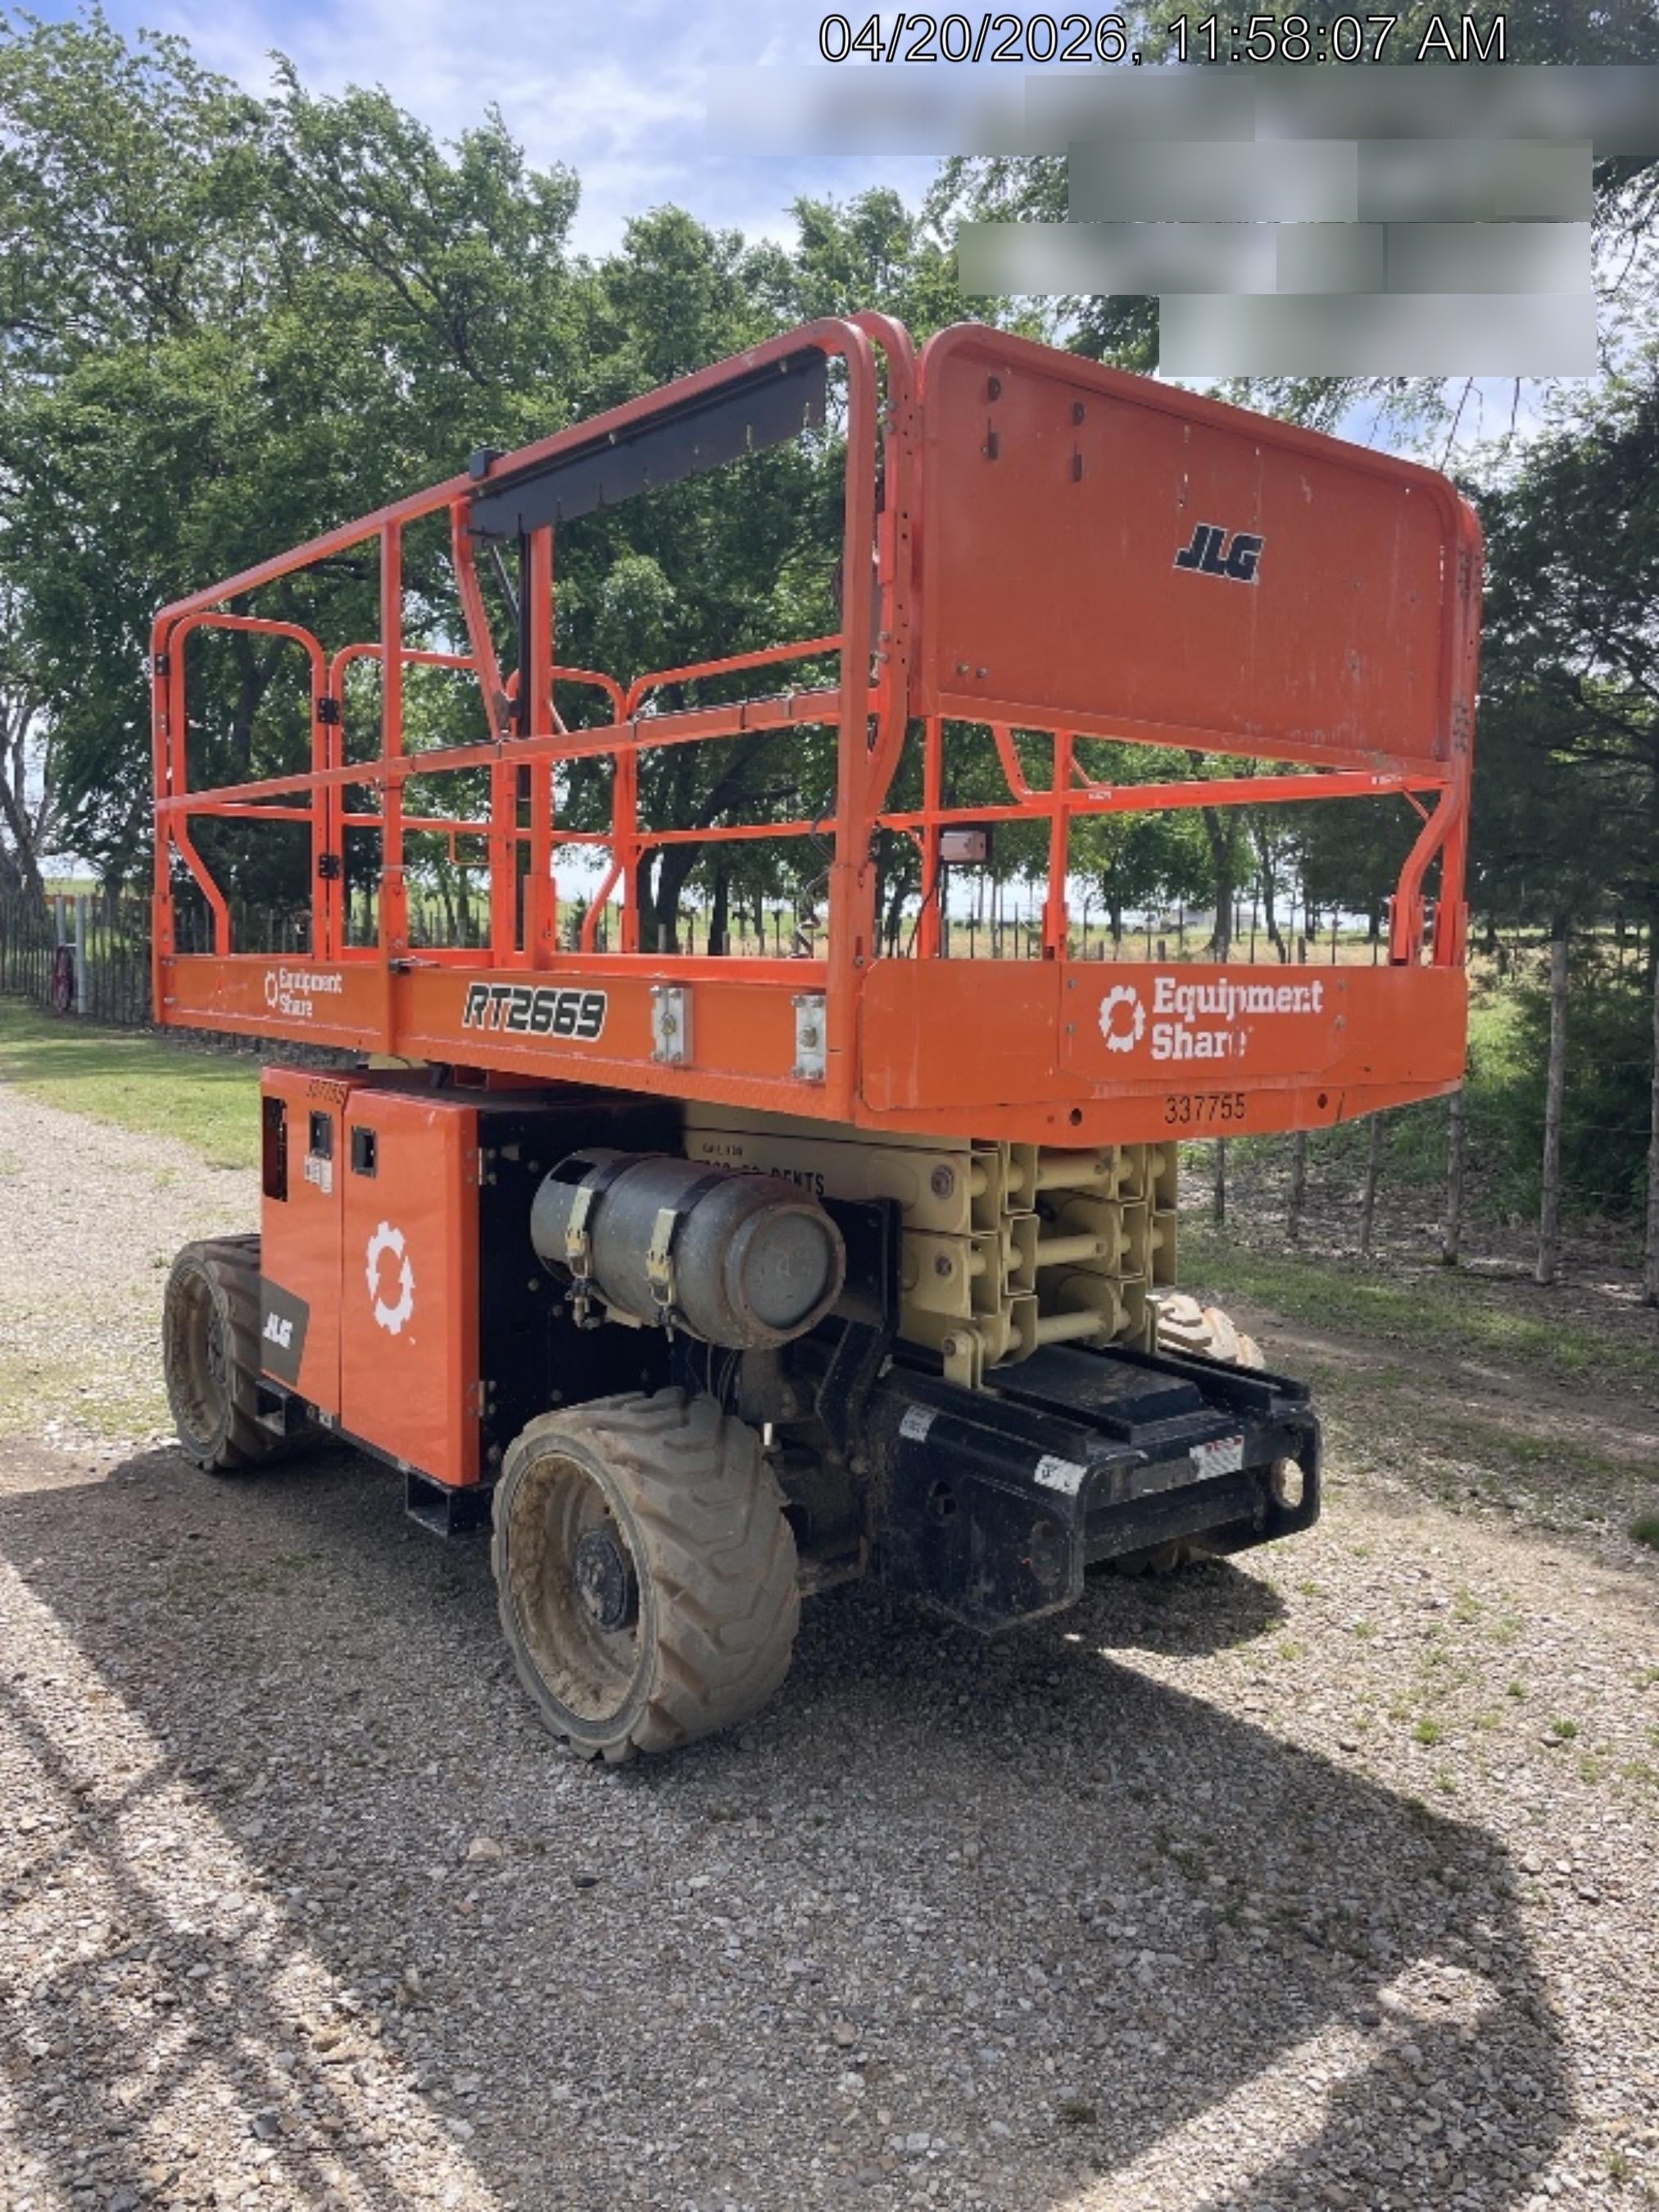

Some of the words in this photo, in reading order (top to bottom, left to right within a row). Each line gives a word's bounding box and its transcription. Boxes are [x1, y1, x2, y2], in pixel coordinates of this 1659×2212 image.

[1173, 522, 1266, 585] JLG
[279, 968, 342, 995] Equipment
[1153, 977, 1323, 1022] Equipment
[279, 993, 313, 1017] Share
[461, 982, 608, 1041] RT2669
[1164, 1093, 1247, 1124] 337755
[262, 1312, 292, 1350] JLG
